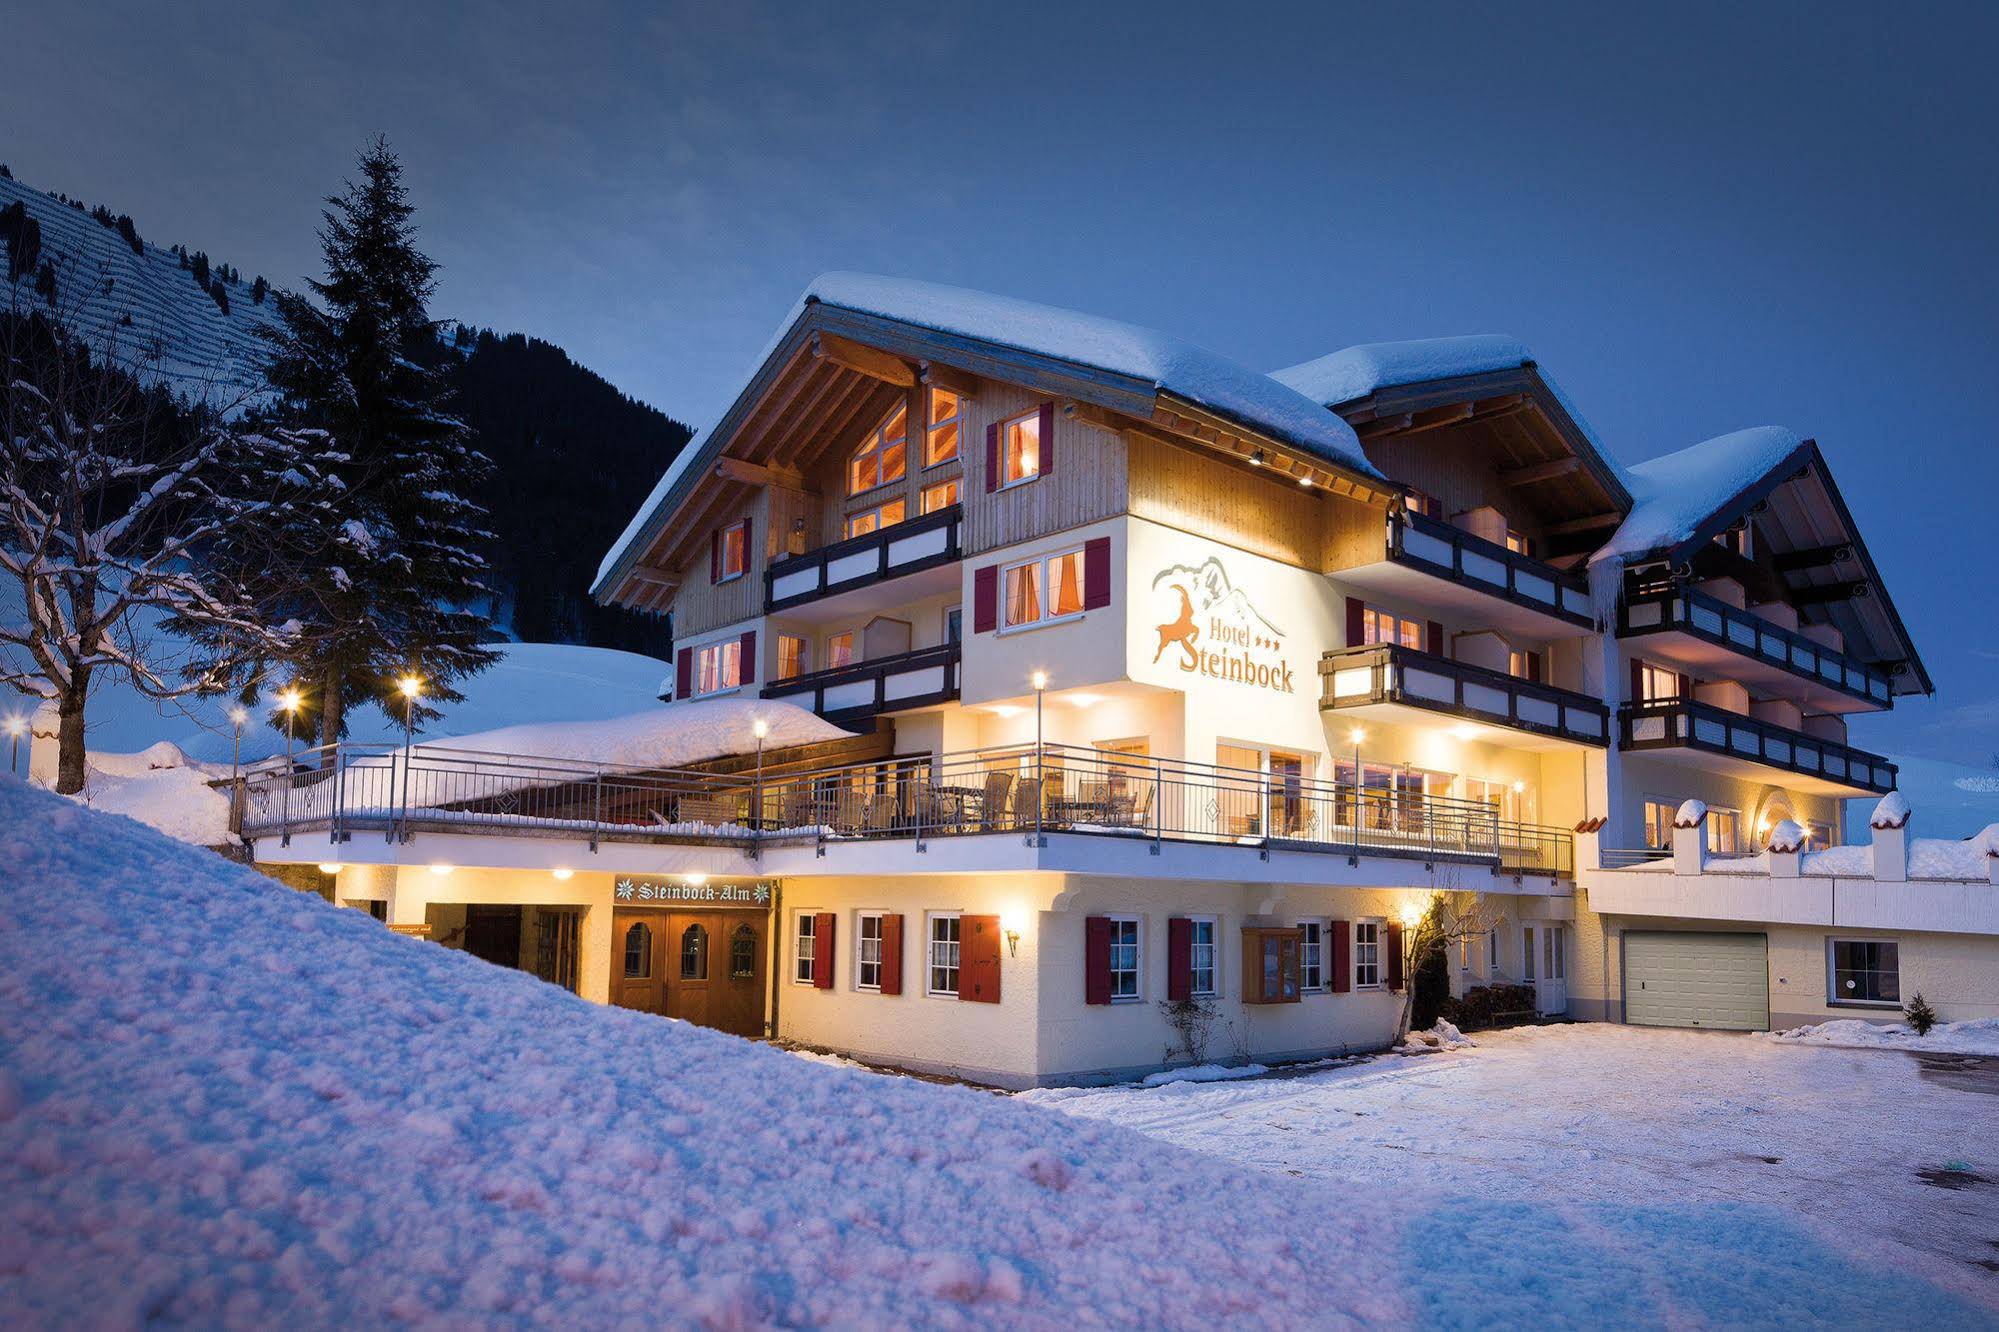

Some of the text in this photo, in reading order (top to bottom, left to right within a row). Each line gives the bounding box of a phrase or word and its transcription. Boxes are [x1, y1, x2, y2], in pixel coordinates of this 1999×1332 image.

[1209, 617, 1250, 648] Hotel
[1180, 645, 1294, 694] Steinbock
[638, 882, 750, 901] Steinbock-Alm
